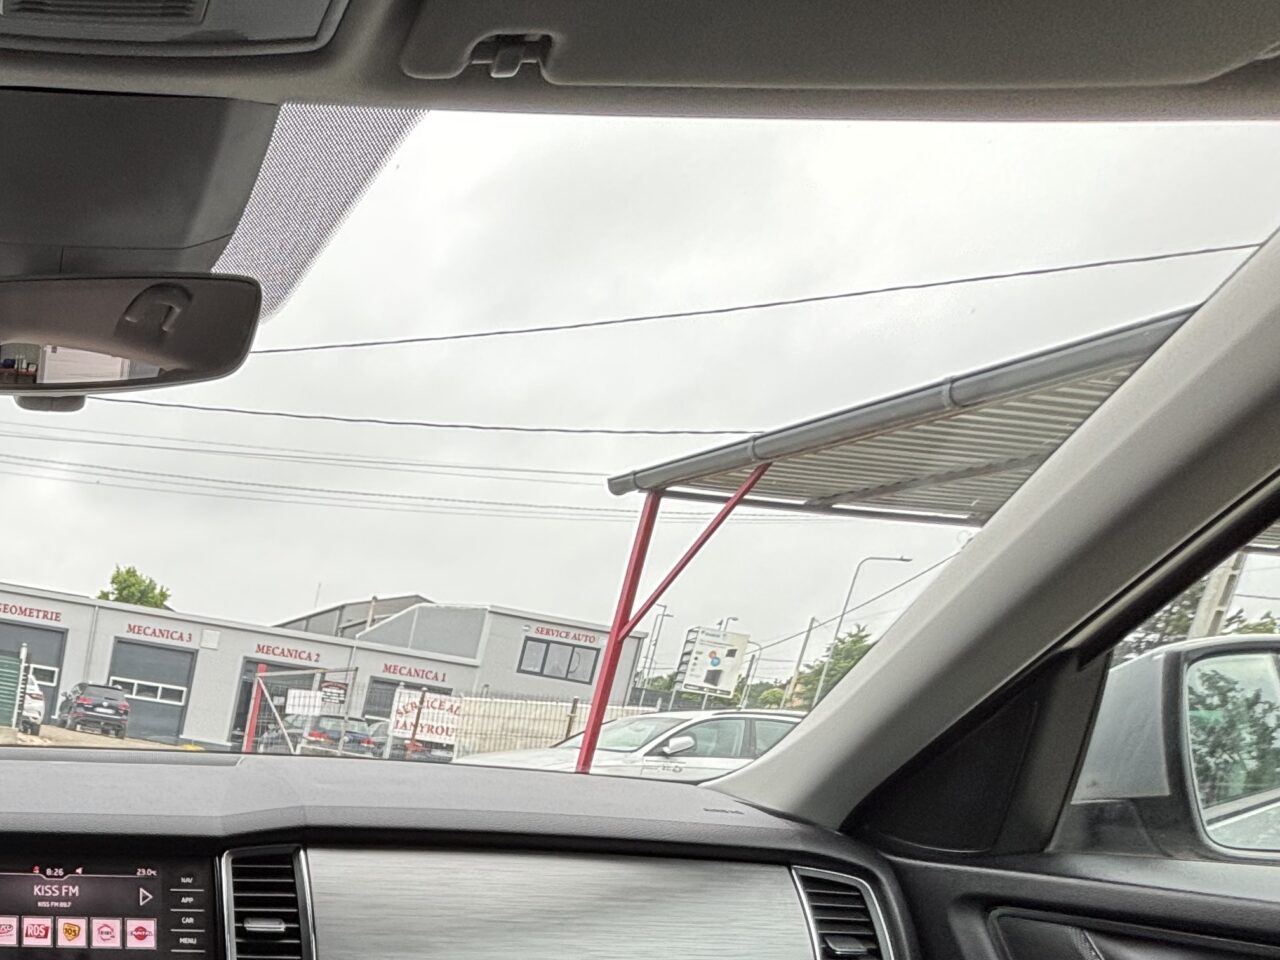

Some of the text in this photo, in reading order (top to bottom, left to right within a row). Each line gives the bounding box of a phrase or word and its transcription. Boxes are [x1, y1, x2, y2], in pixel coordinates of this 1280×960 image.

[126, 623, 193, 643] MECANICA 3
[534, 626, 597, 644] SERVICE AUTO
[255, 643, 321, 663] MECANICA 2
[382, 663, 439, 681] MECANICA
[396, 698, 446, 718] SERICE
[46, 868, 64, 876] 8:26
[33, 884, 79, 897] KISS FM
[27, 926, 47, 937] RDS
